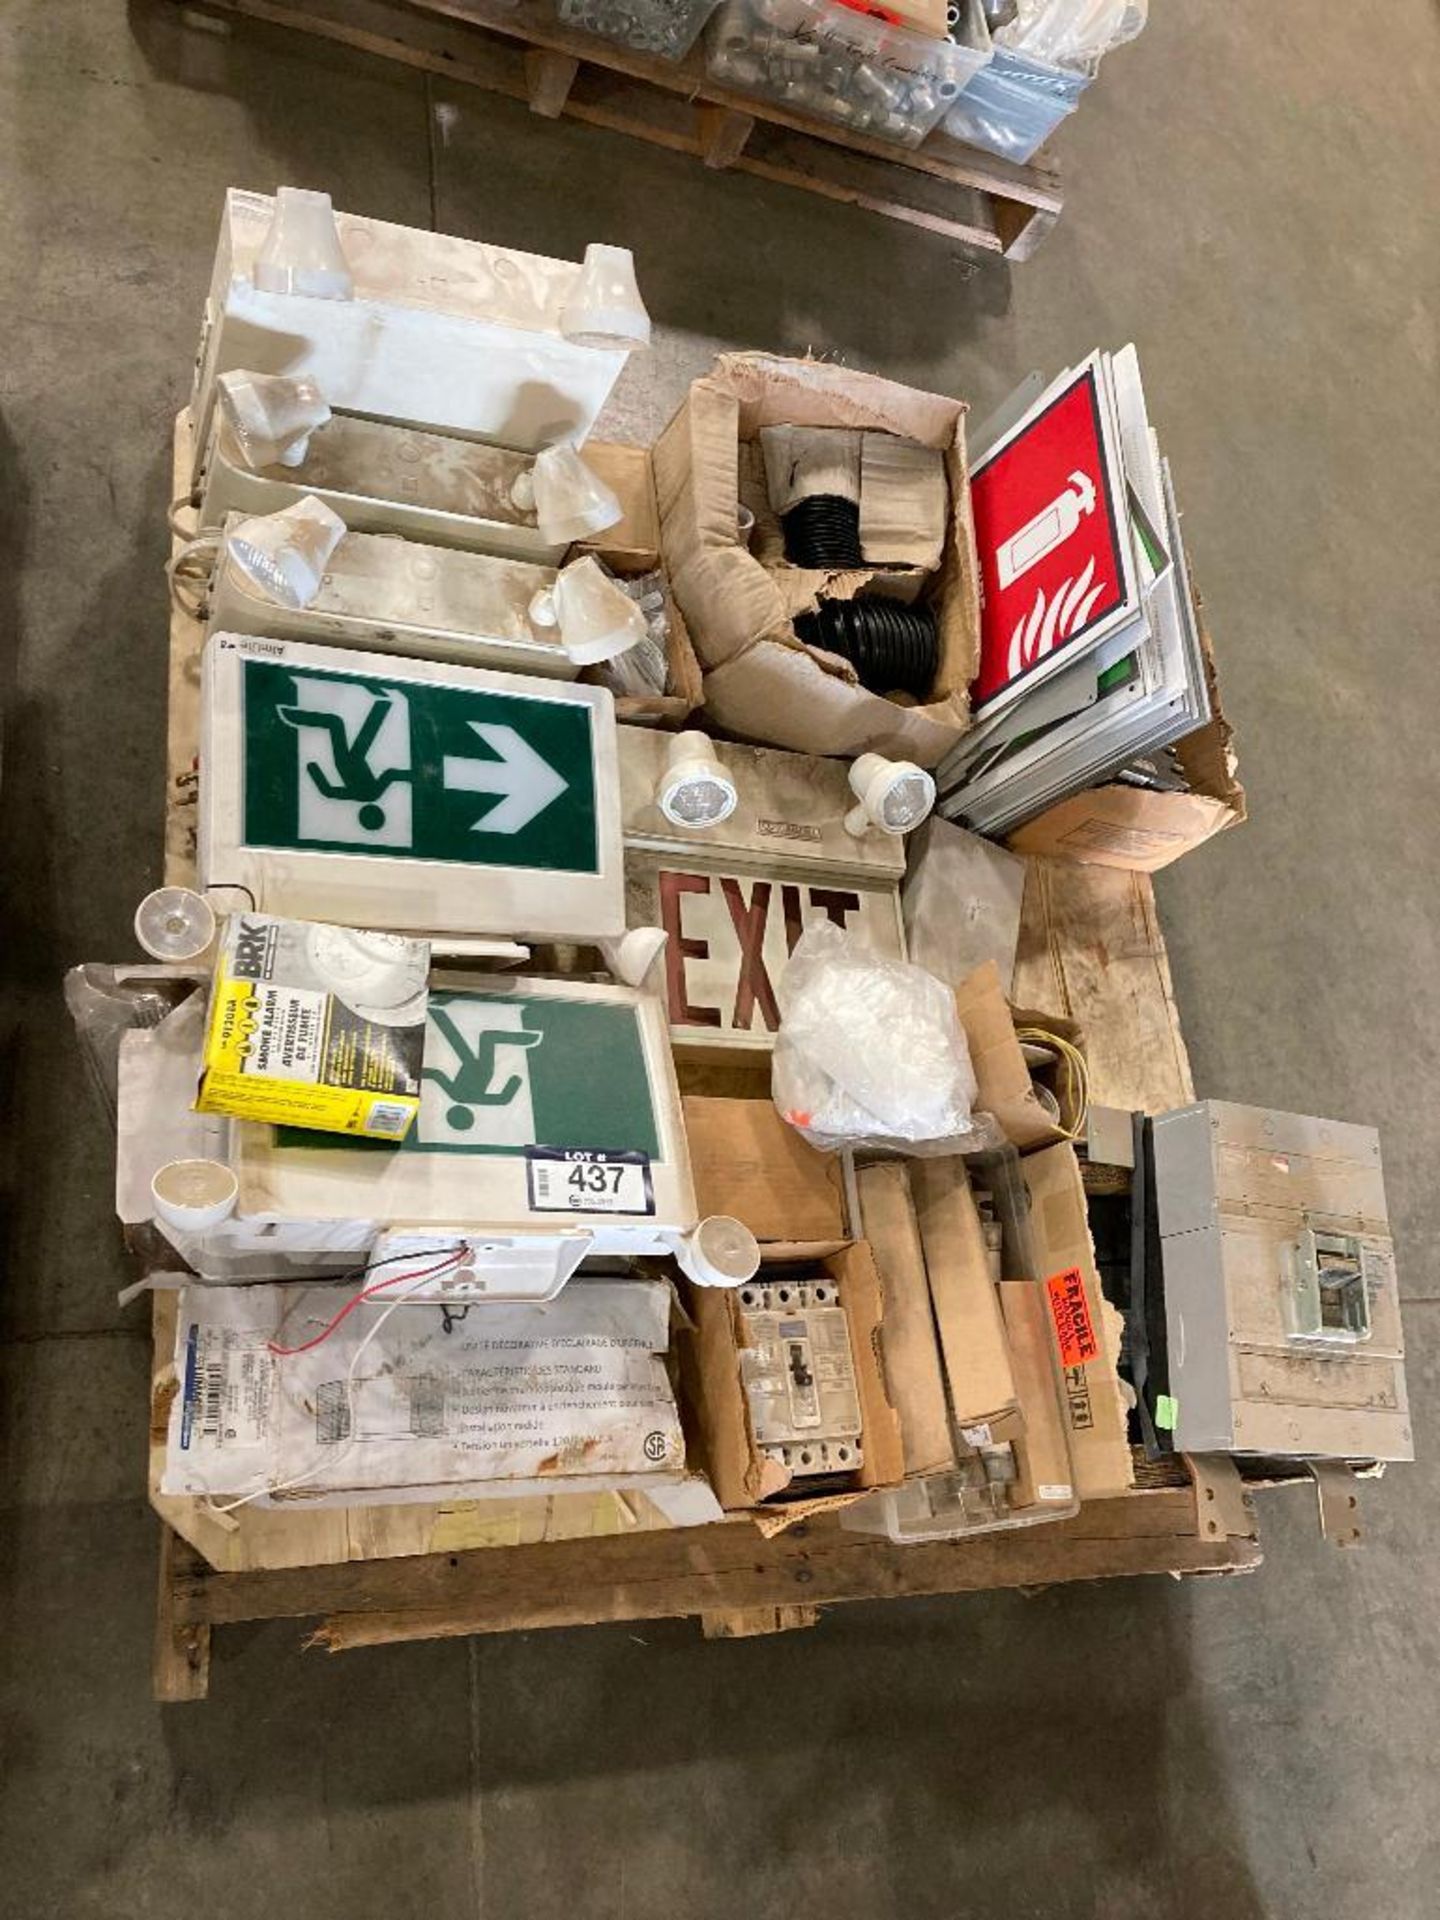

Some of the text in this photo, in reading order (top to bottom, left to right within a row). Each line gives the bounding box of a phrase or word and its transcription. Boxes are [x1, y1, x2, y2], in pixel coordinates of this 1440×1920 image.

[234, 920, 268, 979] BRK
[264, 990, 278, 1022] ALARM
[257, 1021, 273, 1070] SMOKE
[282, 999, 301, 1067] AVERTISSEUR
[295, 1044, 307, 1061] DE
[565, 1151, 607, 1162] LOT #
[568, 1164, 625, 1194] 437
[1064, 1272, 1094, 1358] FRAGILE
